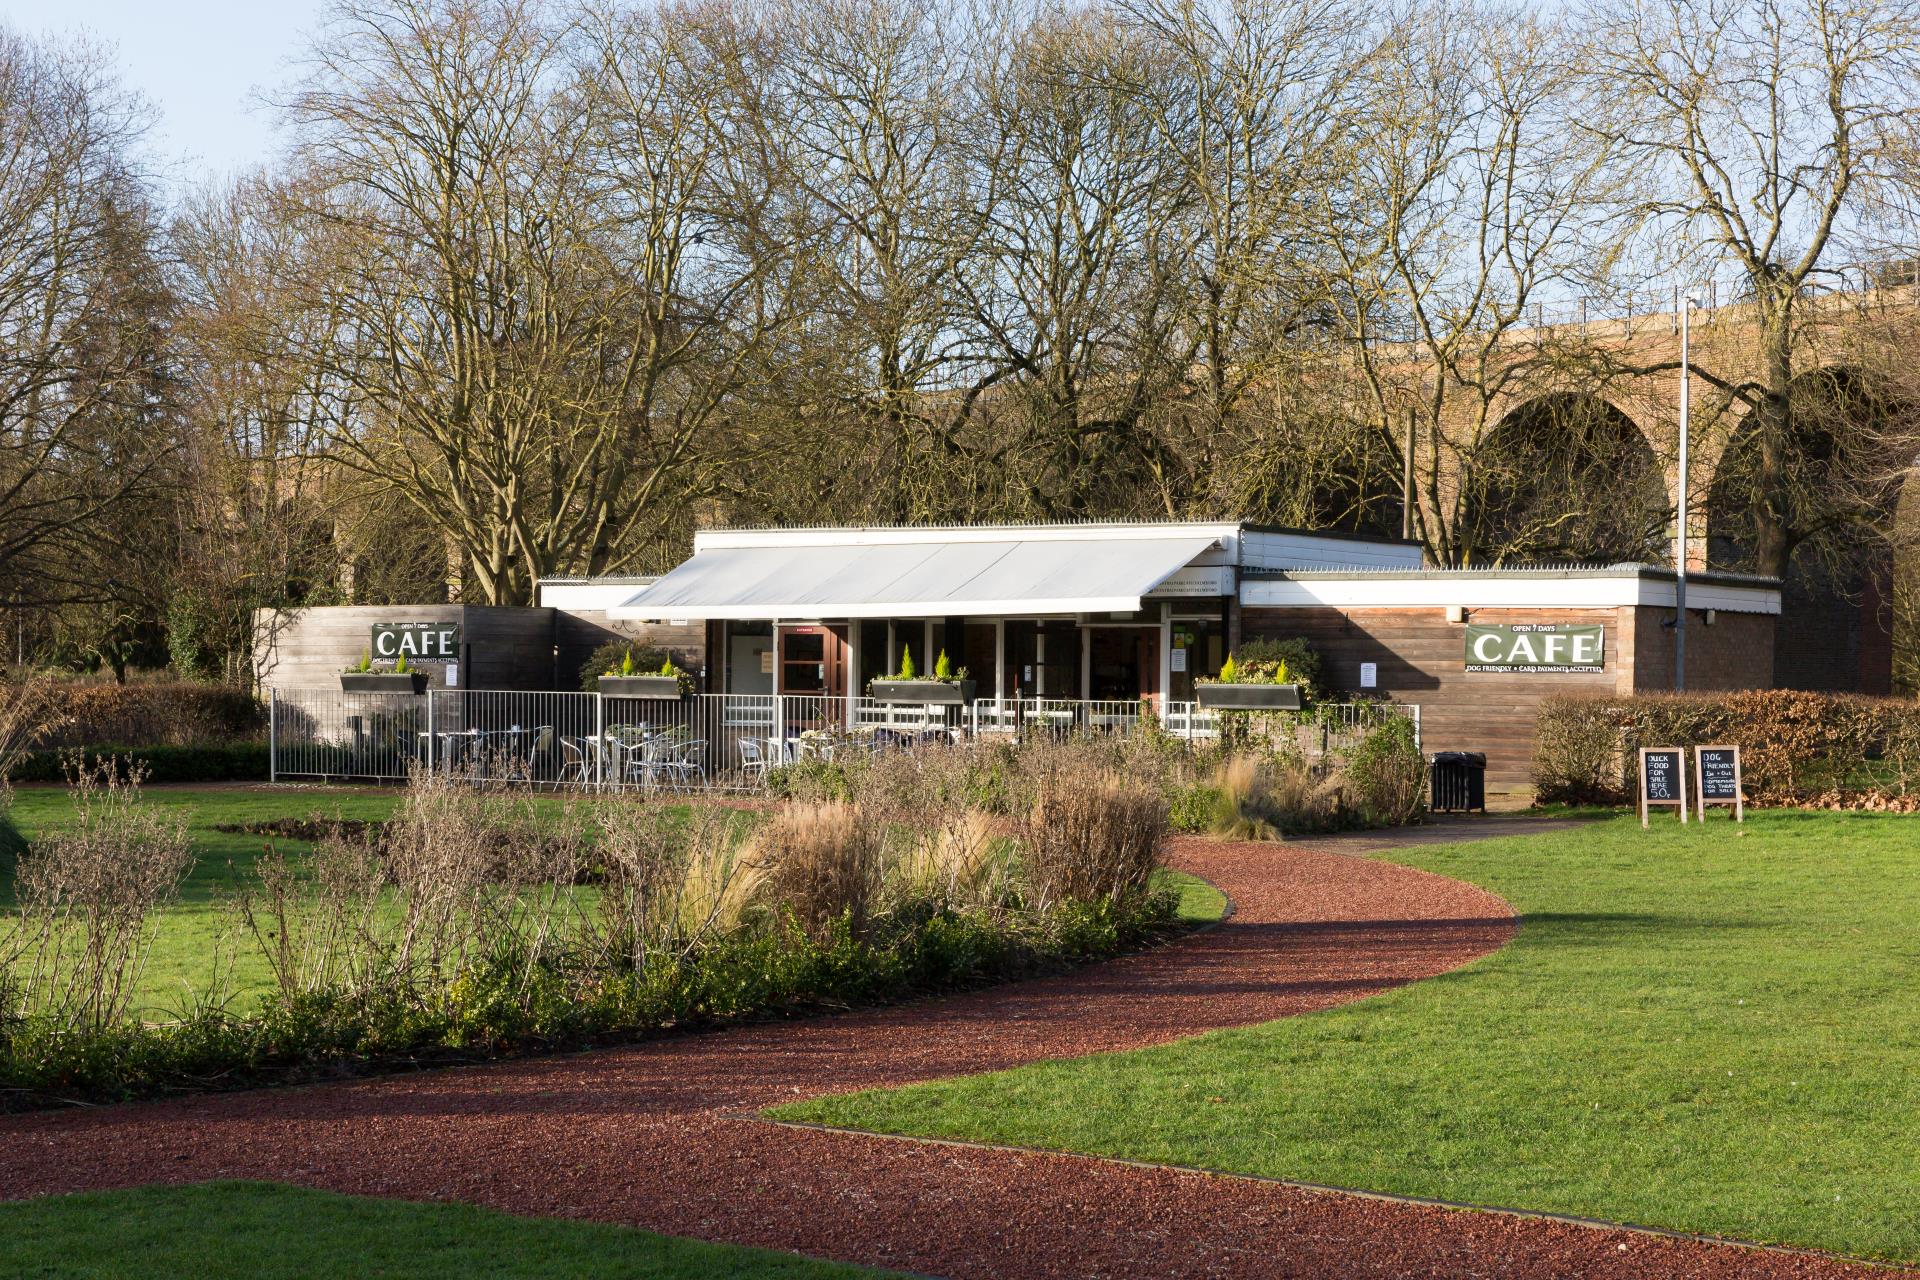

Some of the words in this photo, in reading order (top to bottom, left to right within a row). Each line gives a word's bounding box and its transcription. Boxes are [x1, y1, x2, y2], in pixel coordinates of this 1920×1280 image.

[377, 631, 454, 656] CAFE
[1473, 634, 1595, 663] CAFE
[1703, 753, 1721, 761] DOG
